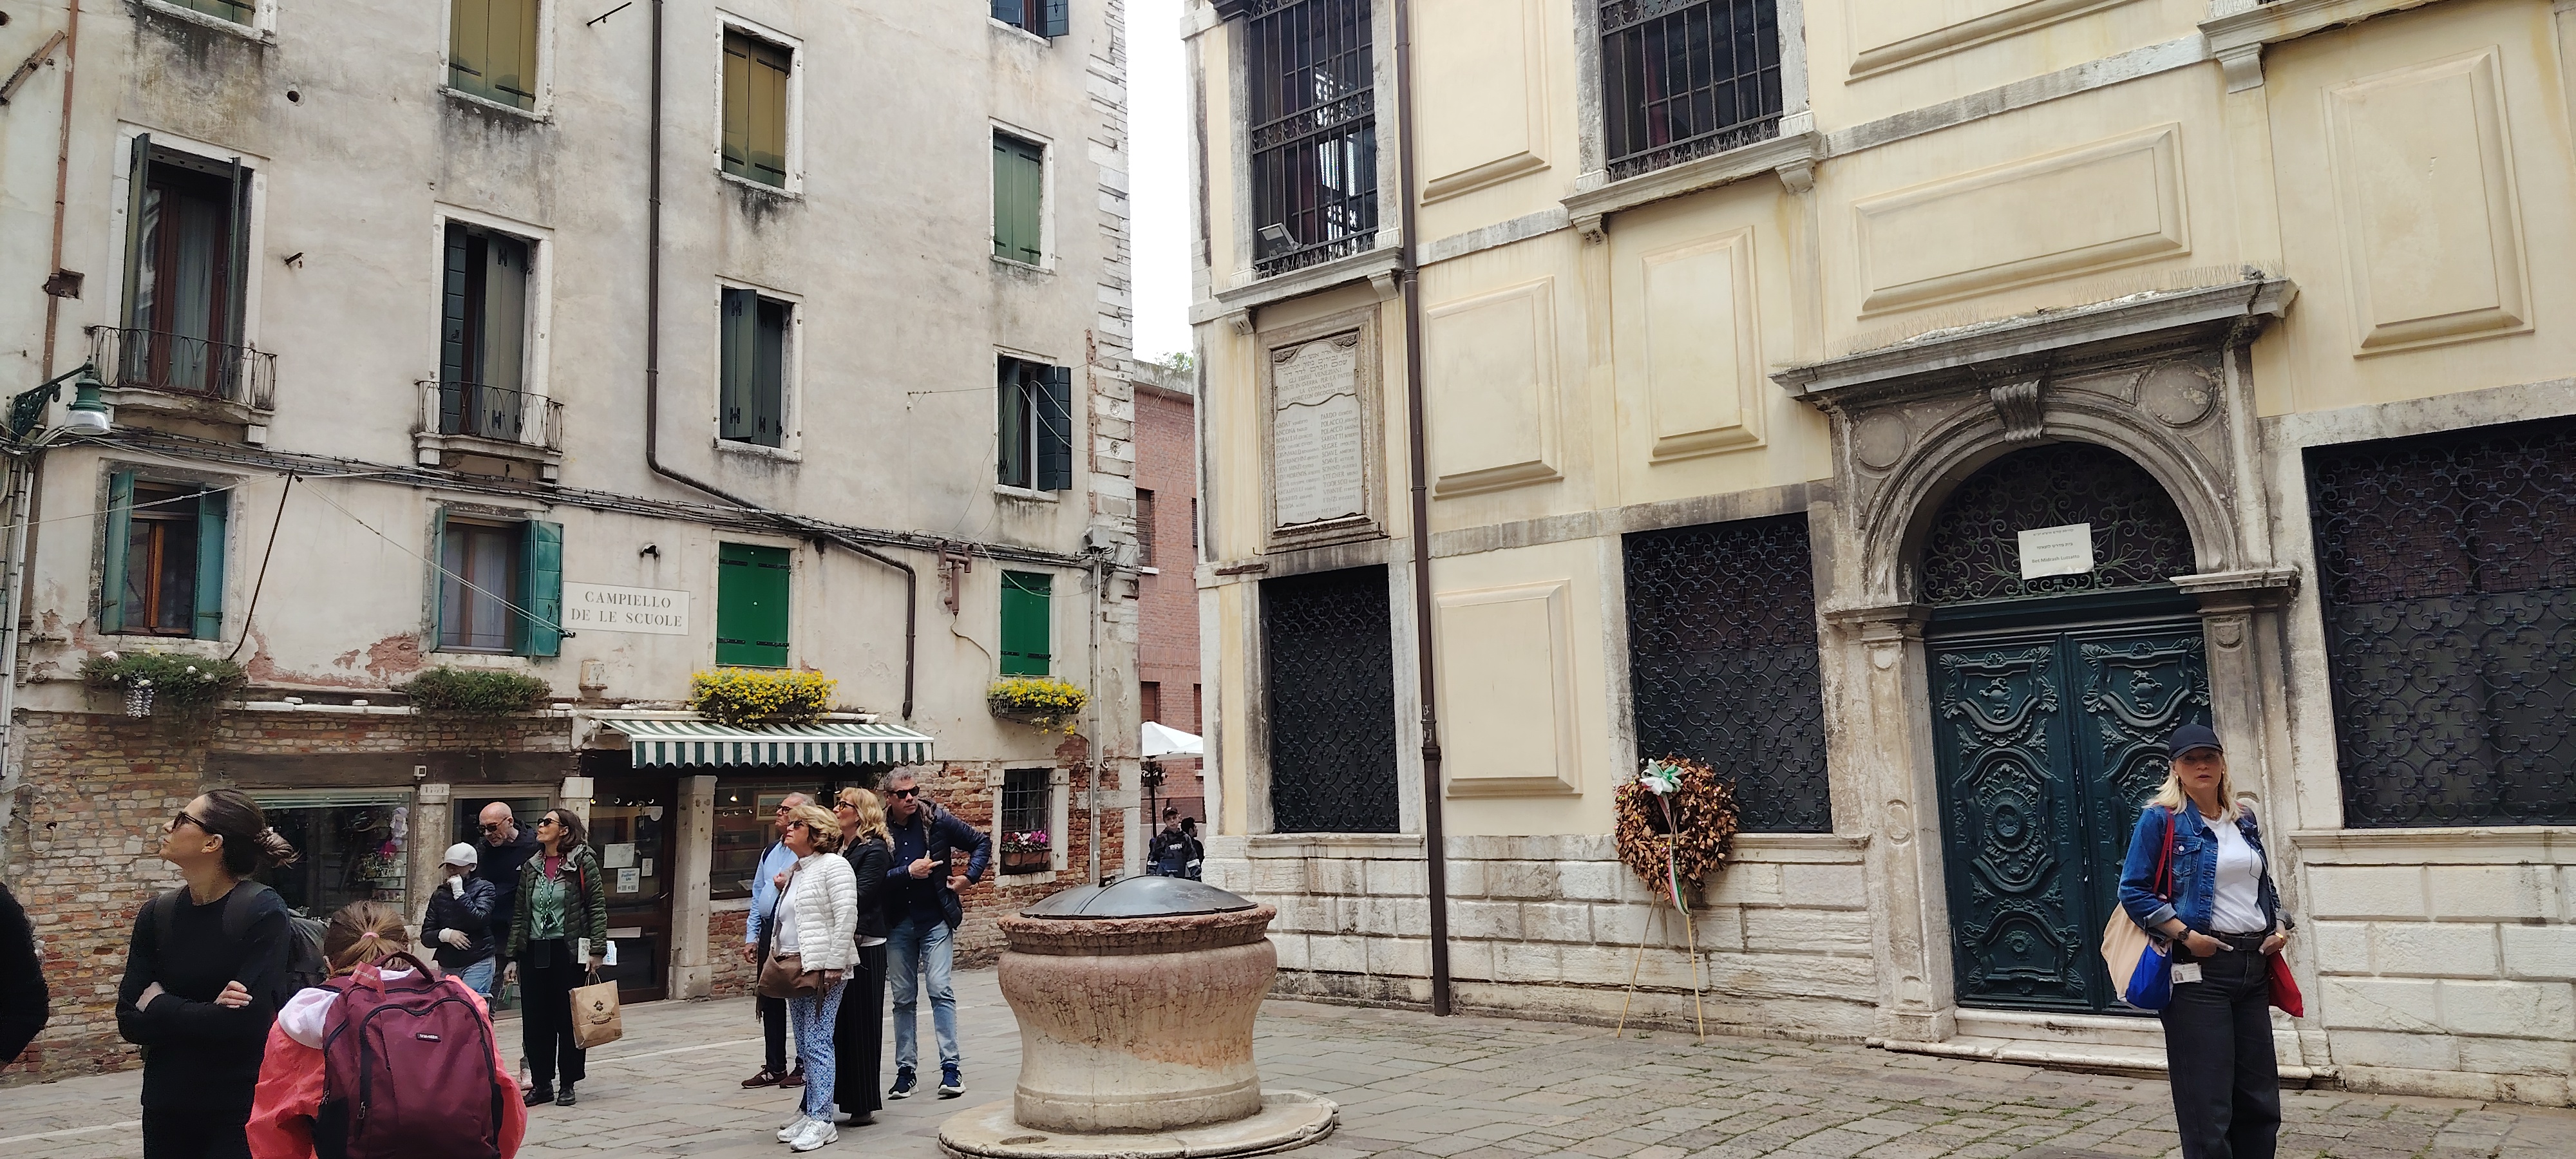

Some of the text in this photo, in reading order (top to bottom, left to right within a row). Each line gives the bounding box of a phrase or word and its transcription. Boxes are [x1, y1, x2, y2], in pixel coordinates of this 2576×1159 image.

[1315, 368, 1341, 377] VENEZIANI
[1321, 418, 1343, 427] POLACCO
[1276, 428, 1295, 436] ANCONA
[1321, 426, 1343, 435] POLACCO
[1321, 433, 1343, 442] SARFATTI
[1322, 457, 1338, 465] SOAVE
[1323, 478, 1347, 487] TODESCO
[585, 591, 671, 608] CAMPIELLO
[571, 608, 682, 627] DE LE SCUOLE
